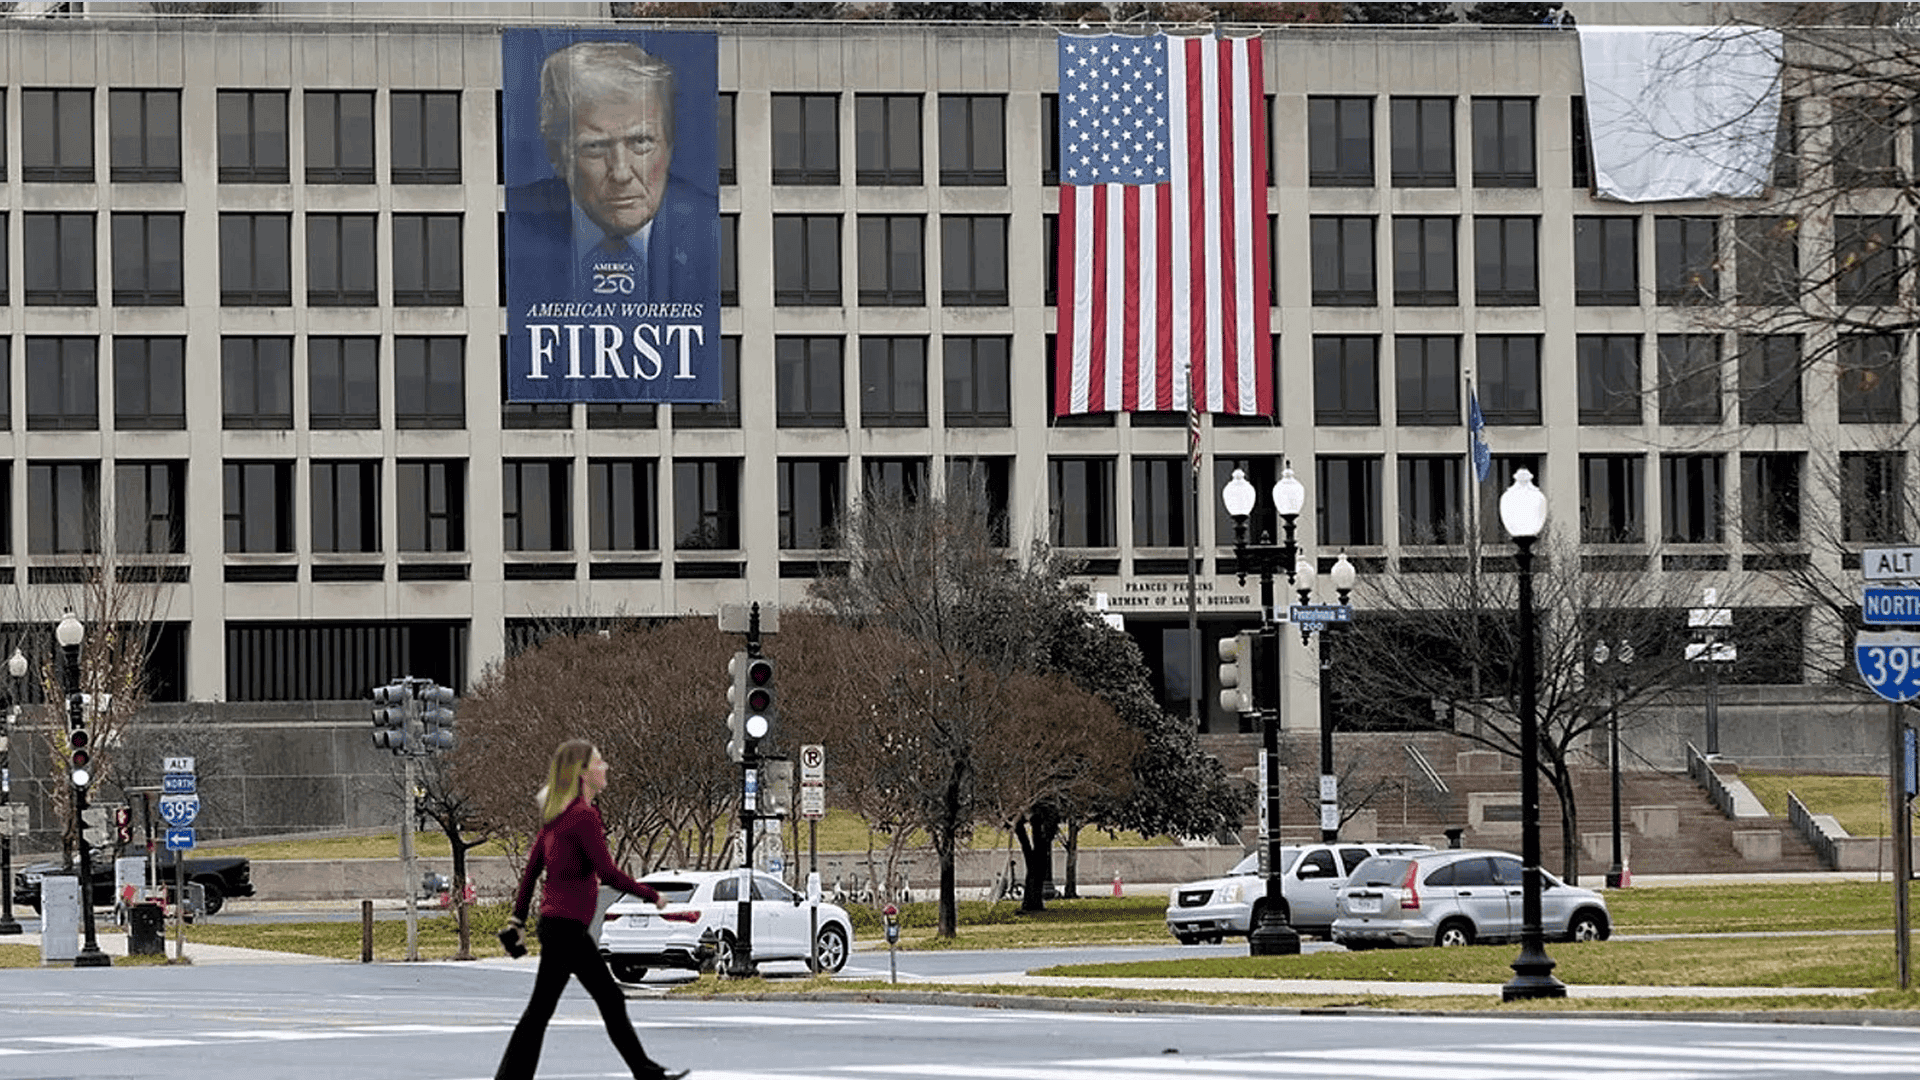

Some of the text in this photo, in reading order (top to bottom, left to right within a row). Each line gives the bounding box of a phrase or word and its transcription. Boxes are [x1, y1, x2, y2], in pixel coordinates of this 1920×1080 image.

[593, 263, 634, 271] AMERICA
[593, 273, 635, 294] 250
[526, 303, 703, 317] AMERICAN WORKERS
[525, 323, 704, 380] FIRST
[1877, 553, 1913, 573] ALT
[1126, 583, 1167, 592] FRANCES
[1155, 597, 1166, 605] OF
[1208, 596, 1250, 605] BUILDING
[170, 760, 187, 769] ALT
[164, 802, 195, 820] 395
